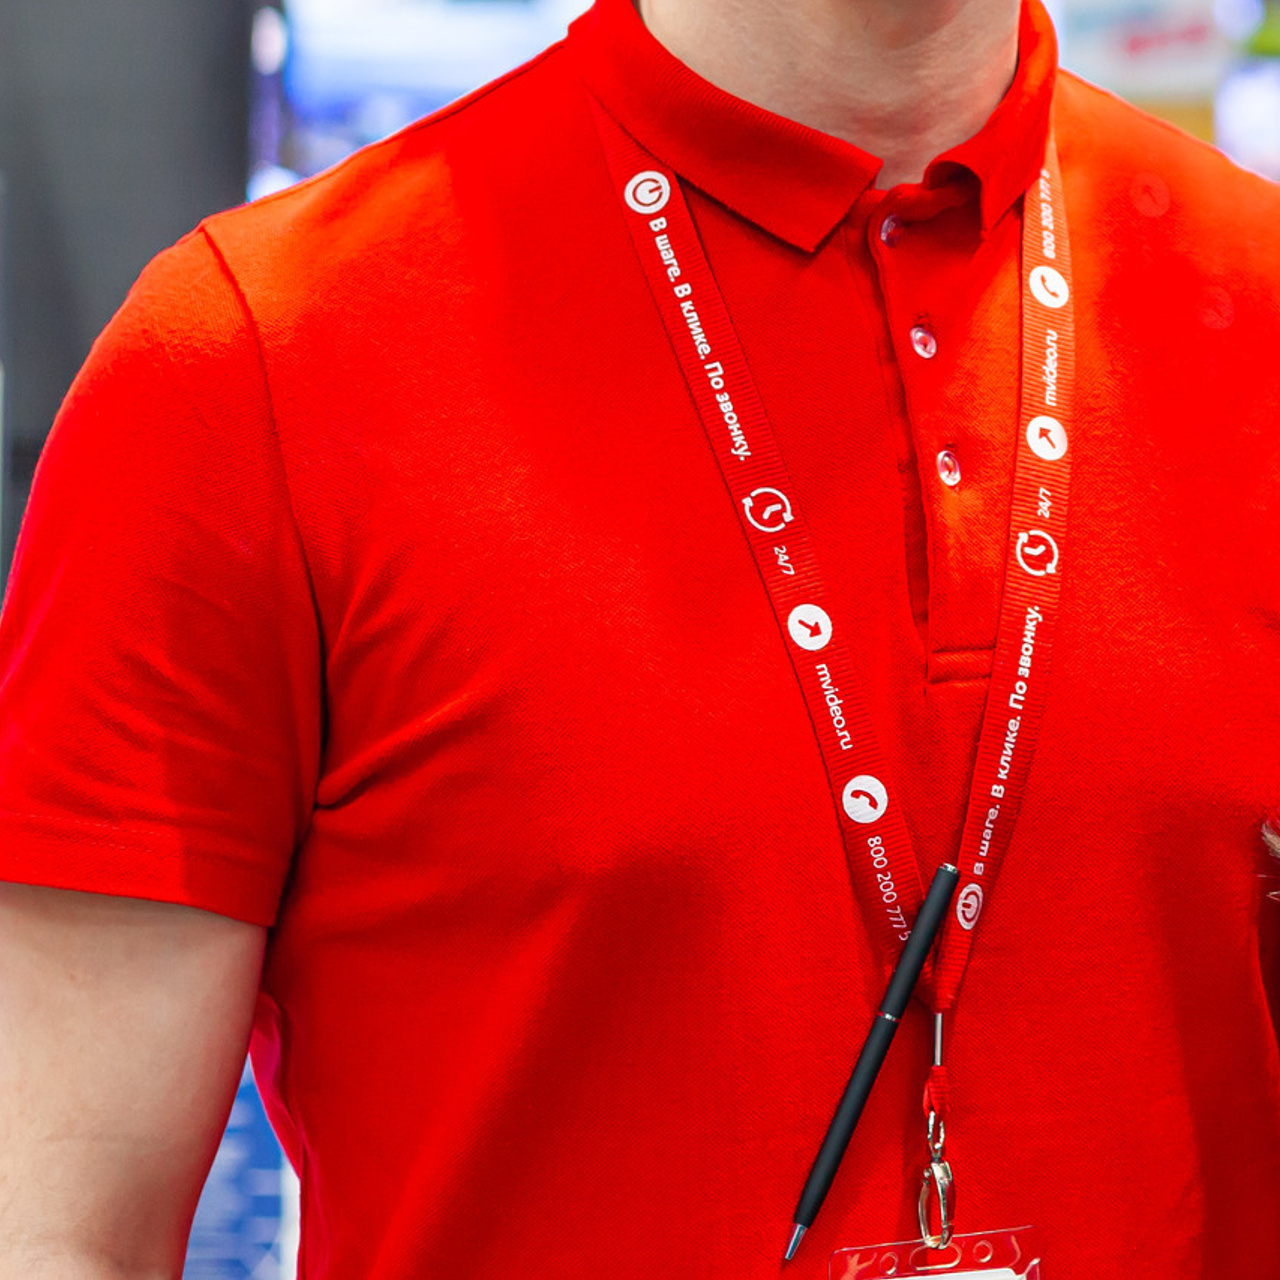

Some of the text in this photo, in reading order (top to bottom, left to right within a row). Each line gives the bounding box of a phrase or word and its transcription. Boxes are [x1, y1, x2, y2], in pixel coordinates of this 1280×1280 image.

[648, 216, 752, 461] В шаге. В клике. По звонку.
[1043, 329, 1059, 407] mvideo.ru
[1037, 486, 1052, 519] 24/7
[773, 545, 795, 576] 24/7
[815, 663, 853, 751] mvideo.ru
[973, 605, 1043, 876] В шаге. В клике. По звонку.
[867, 835, 888, 869] 800
[876, 871, 897, 903] 200
[886, 905, 907, 928] 777
